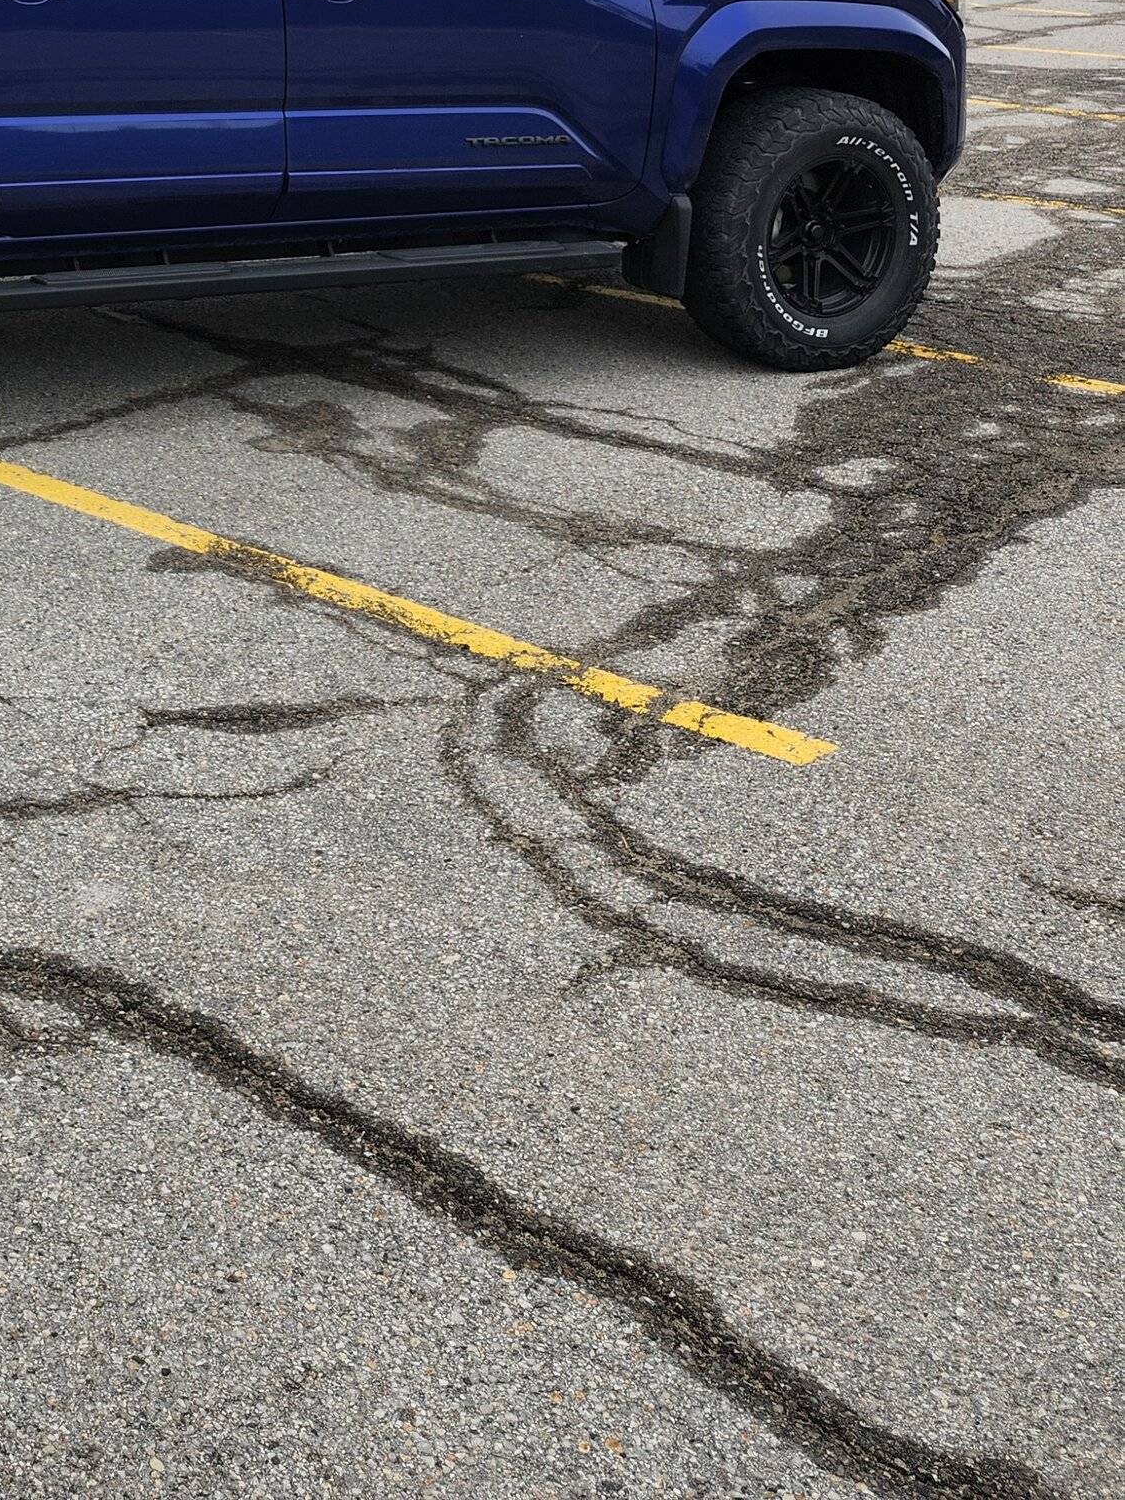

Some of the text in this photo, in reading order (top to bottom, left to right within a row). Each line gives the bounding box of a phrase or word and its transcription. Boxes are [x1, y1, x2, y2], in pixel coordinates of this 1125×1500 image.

[465, 134, 572, 147] TACOMA
[836, 135, 919, 246] All-Terrain T/A
